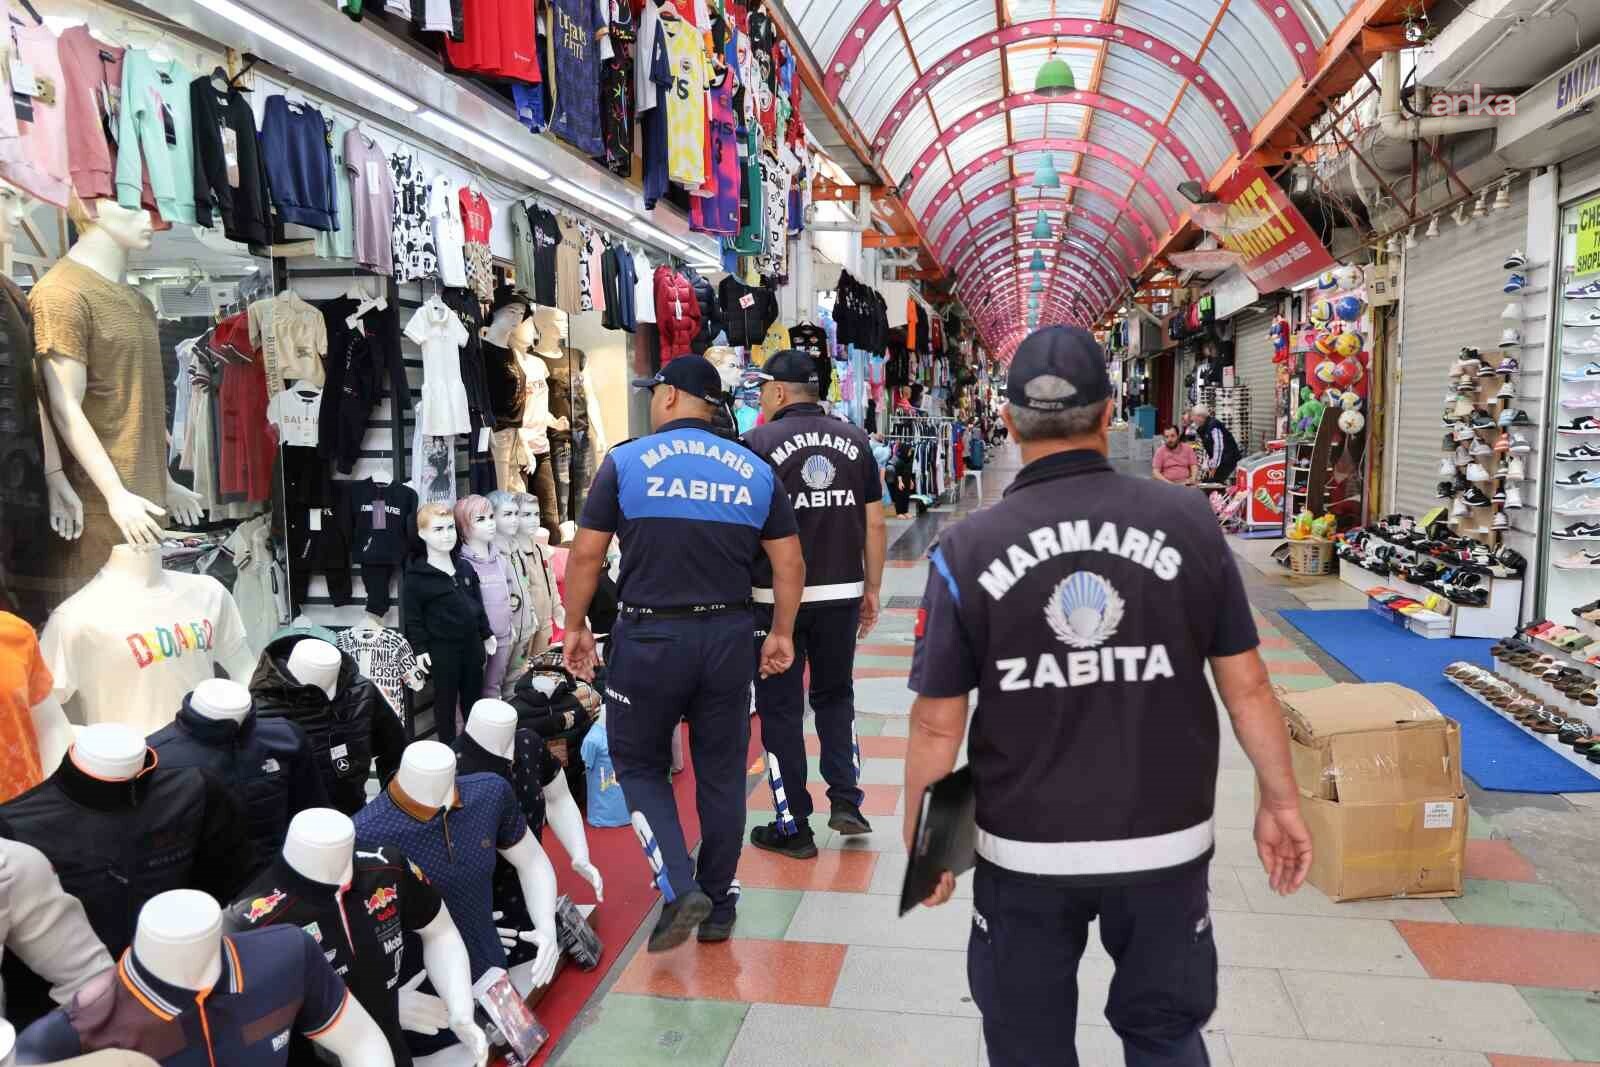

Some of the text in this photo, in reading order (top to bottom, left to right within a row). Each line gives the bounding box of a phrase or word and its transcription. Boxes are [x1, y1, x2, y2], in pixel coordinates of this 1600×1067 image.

[646, 476, 753, 506] ZABITA
[787, 489, 857, 510] ABITA
[995, 643, 1176, 692] ZABITA
